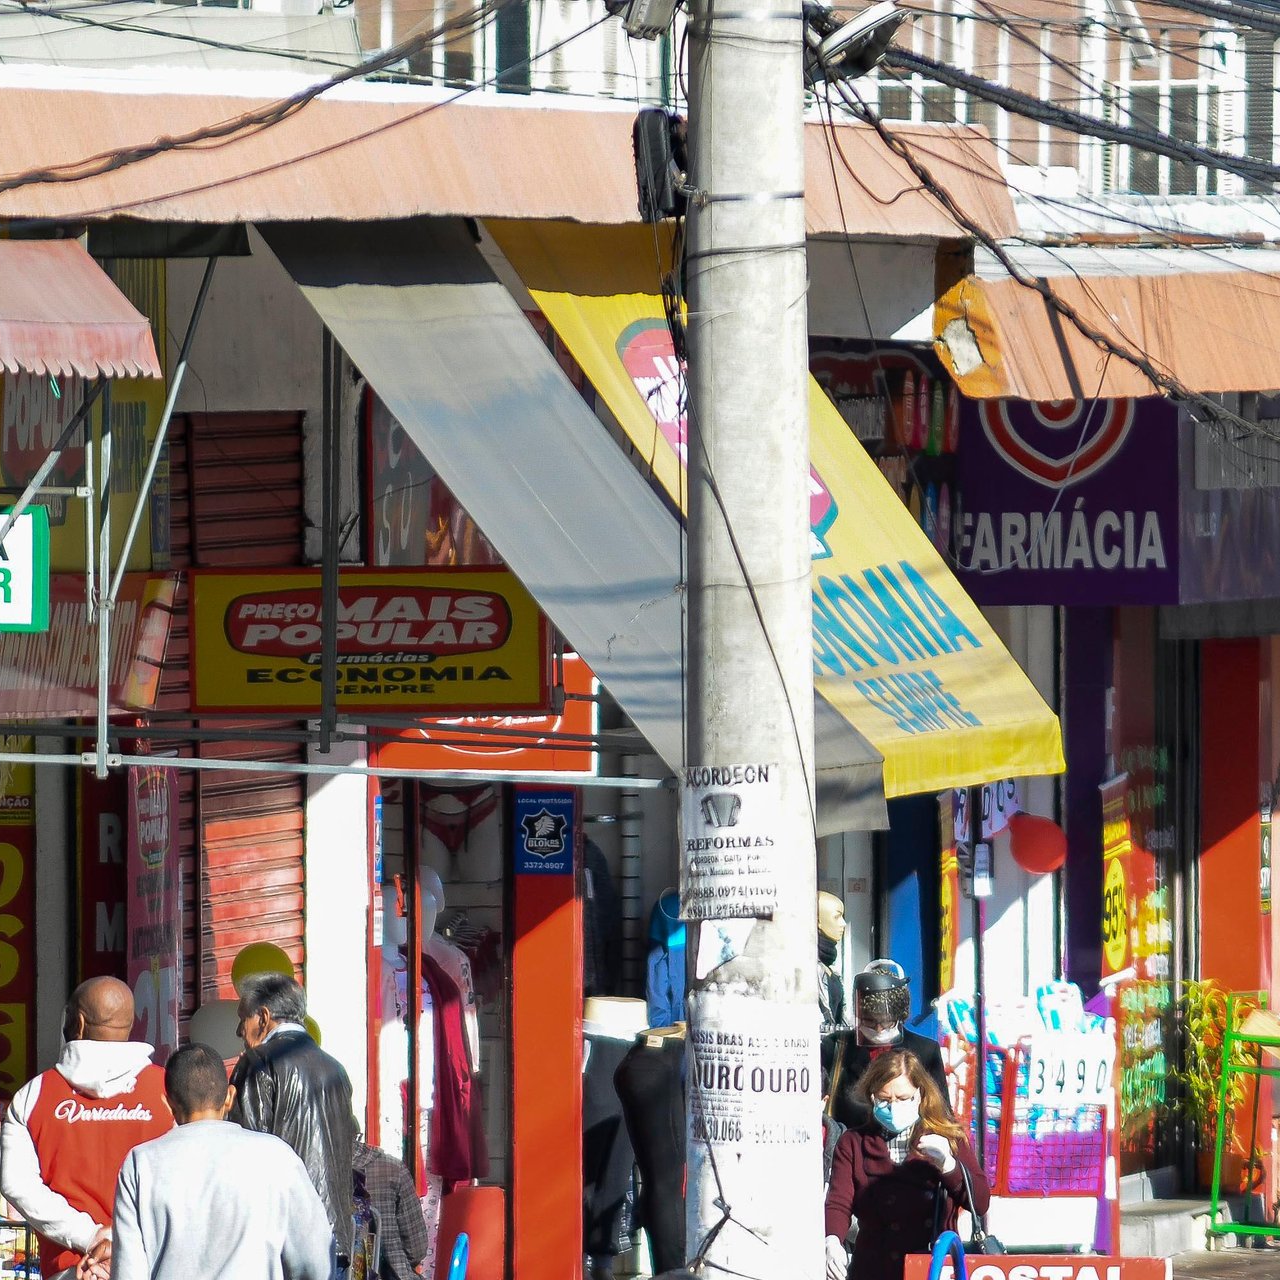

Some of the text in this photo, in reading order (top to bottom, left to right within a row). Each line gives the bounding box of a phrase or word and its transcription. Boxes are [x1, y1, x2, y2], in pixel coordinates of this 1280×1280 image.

[956, 497, 1167, 568] FARMÁCIA
[238, 596, 493, 623] PREÇO MAIS
[241, 622, 498, 647] POPULAR
[307, 652, 429, 665] Frmácias
[686, 764, 770, 788] ACORDEON
[686, 835, 775, 852] REFORMAS
[751, 1066, 810, 1093] OURO
[55, 1099, 153, 1122] Variedades
